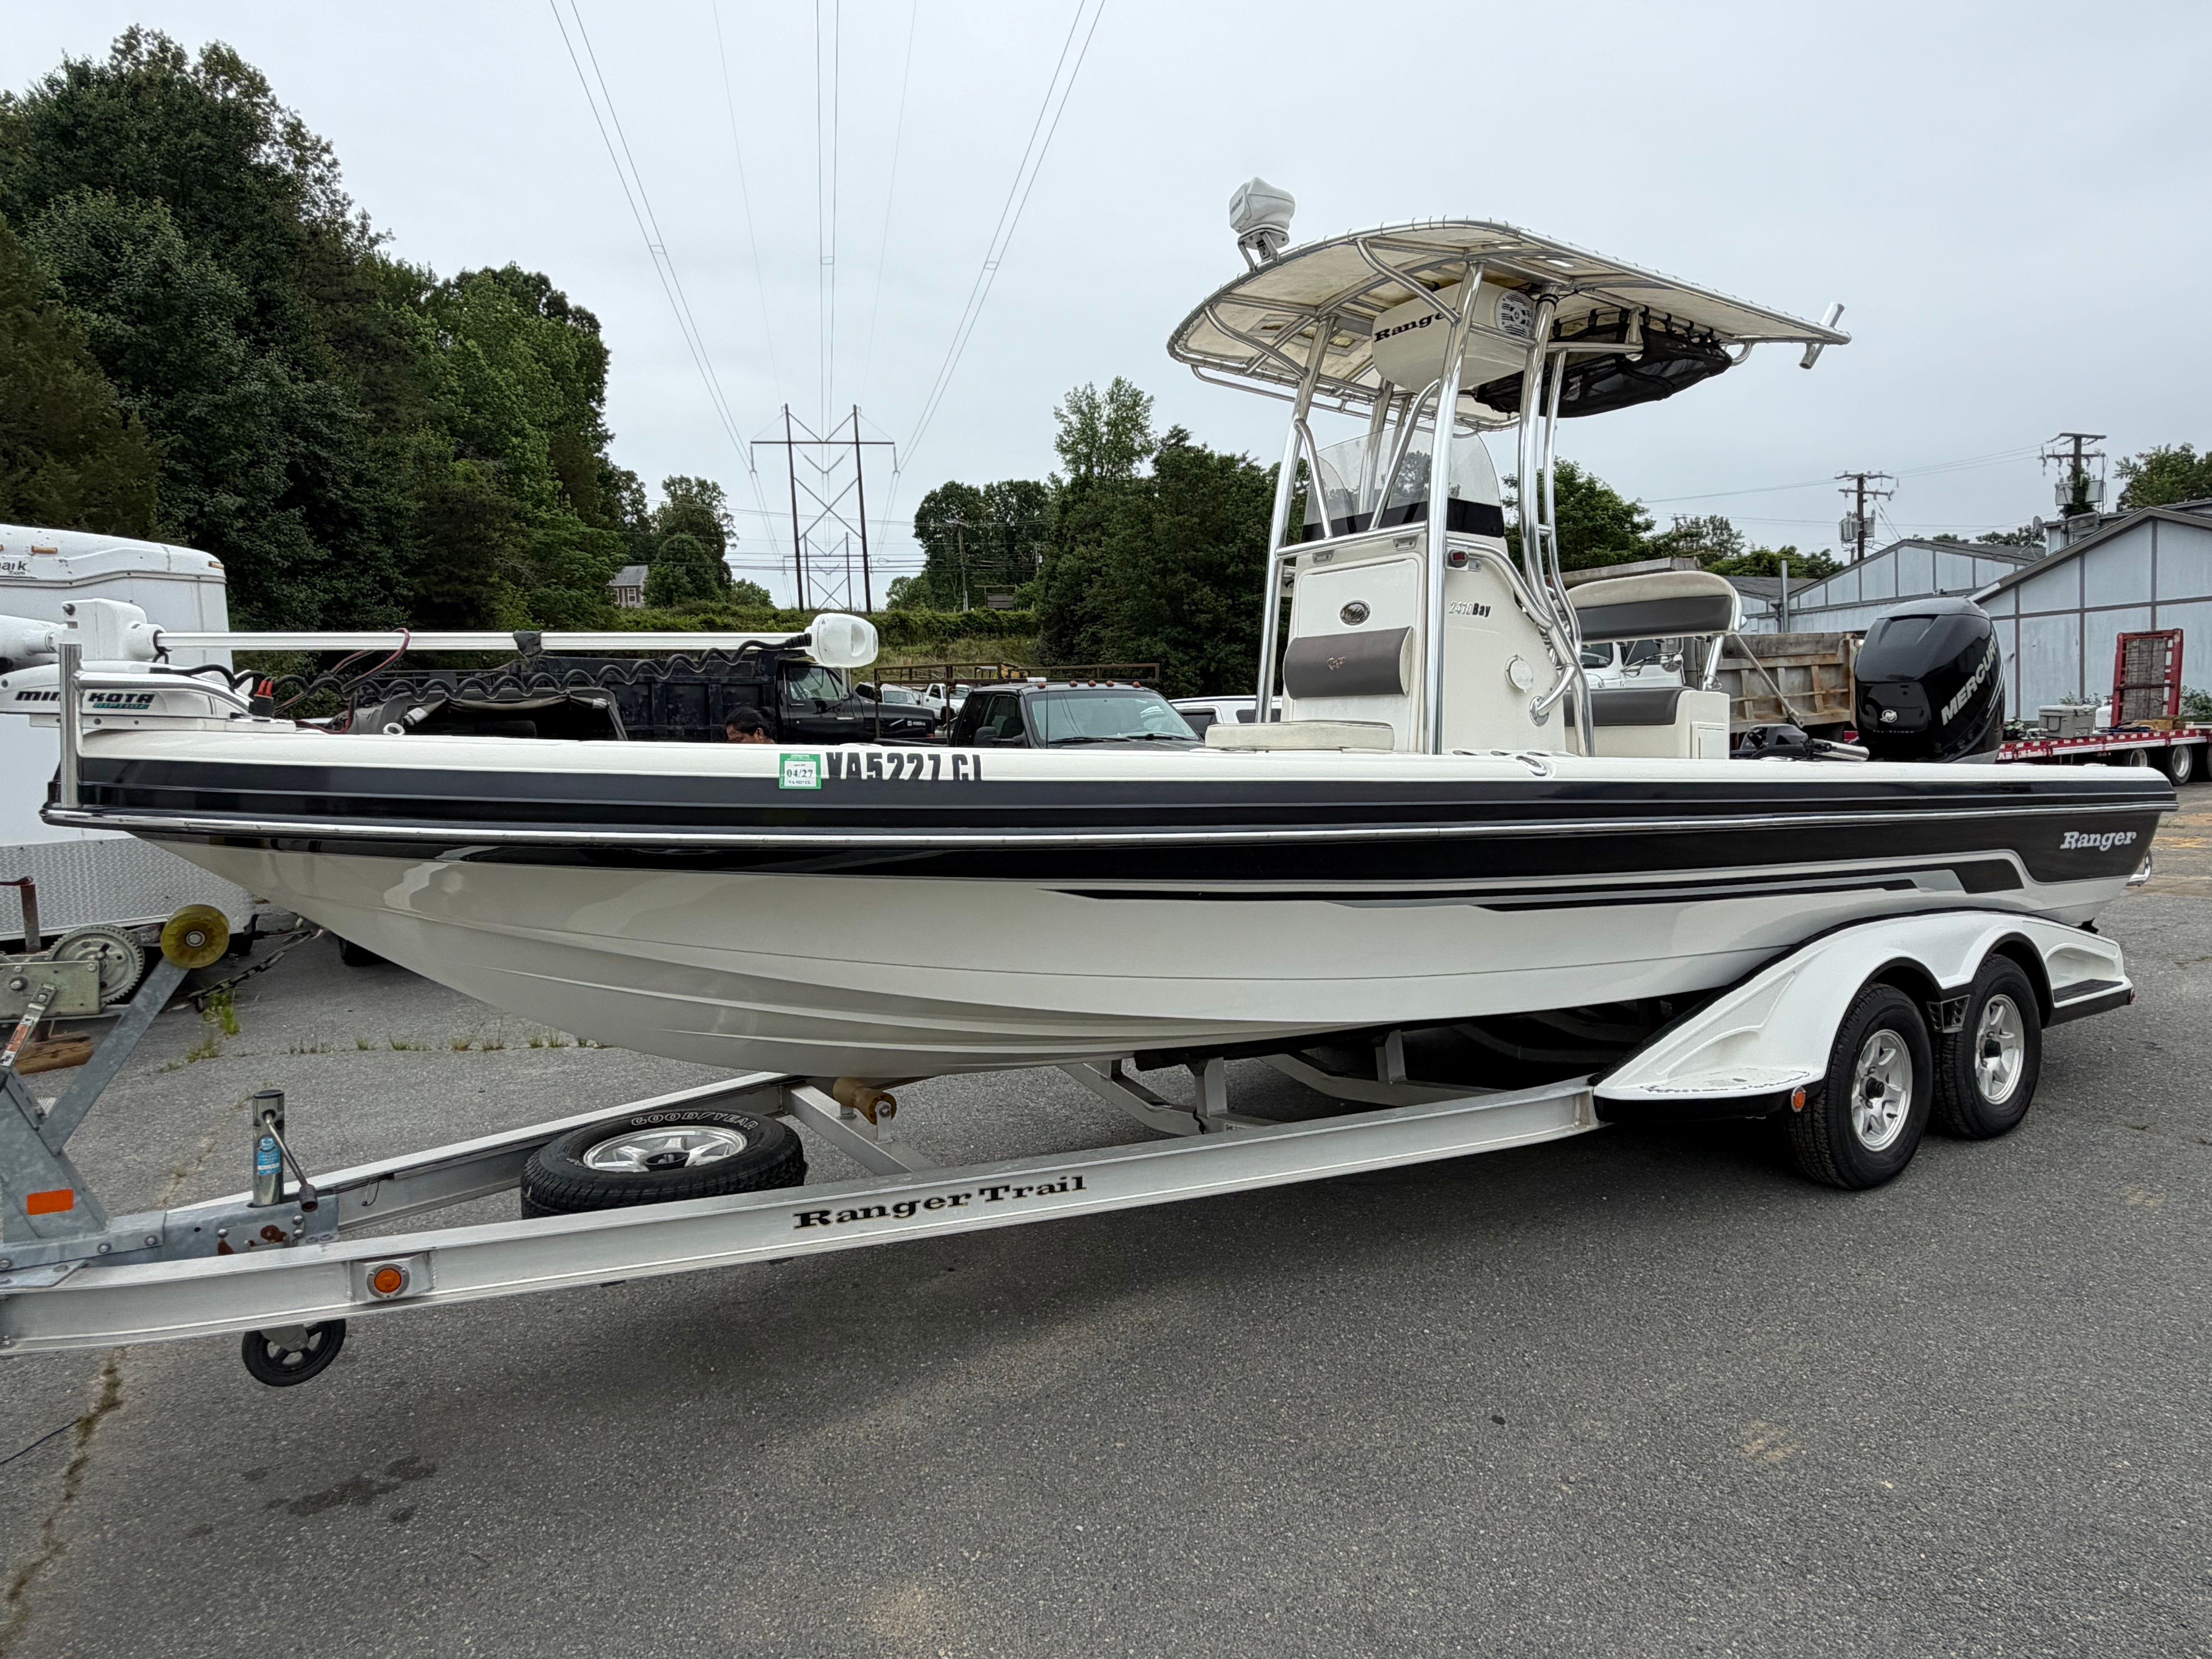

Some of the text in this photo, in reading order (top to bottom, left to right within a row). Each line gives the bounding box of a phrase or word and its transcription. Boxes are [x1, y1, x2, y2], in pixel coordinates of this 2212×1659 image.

[1374, 307, 1455, 342] Range
[0, 561, 27, 571] ark
[1941, 627, 1997, 726] MERCURY
[88, 693, 155, 703] KOTA
[787, 769, 813, 778] 04/27
[2060, 831, 2137, 851] Ranger
[793, 1176, 1087, 1230] Ranger Trail
